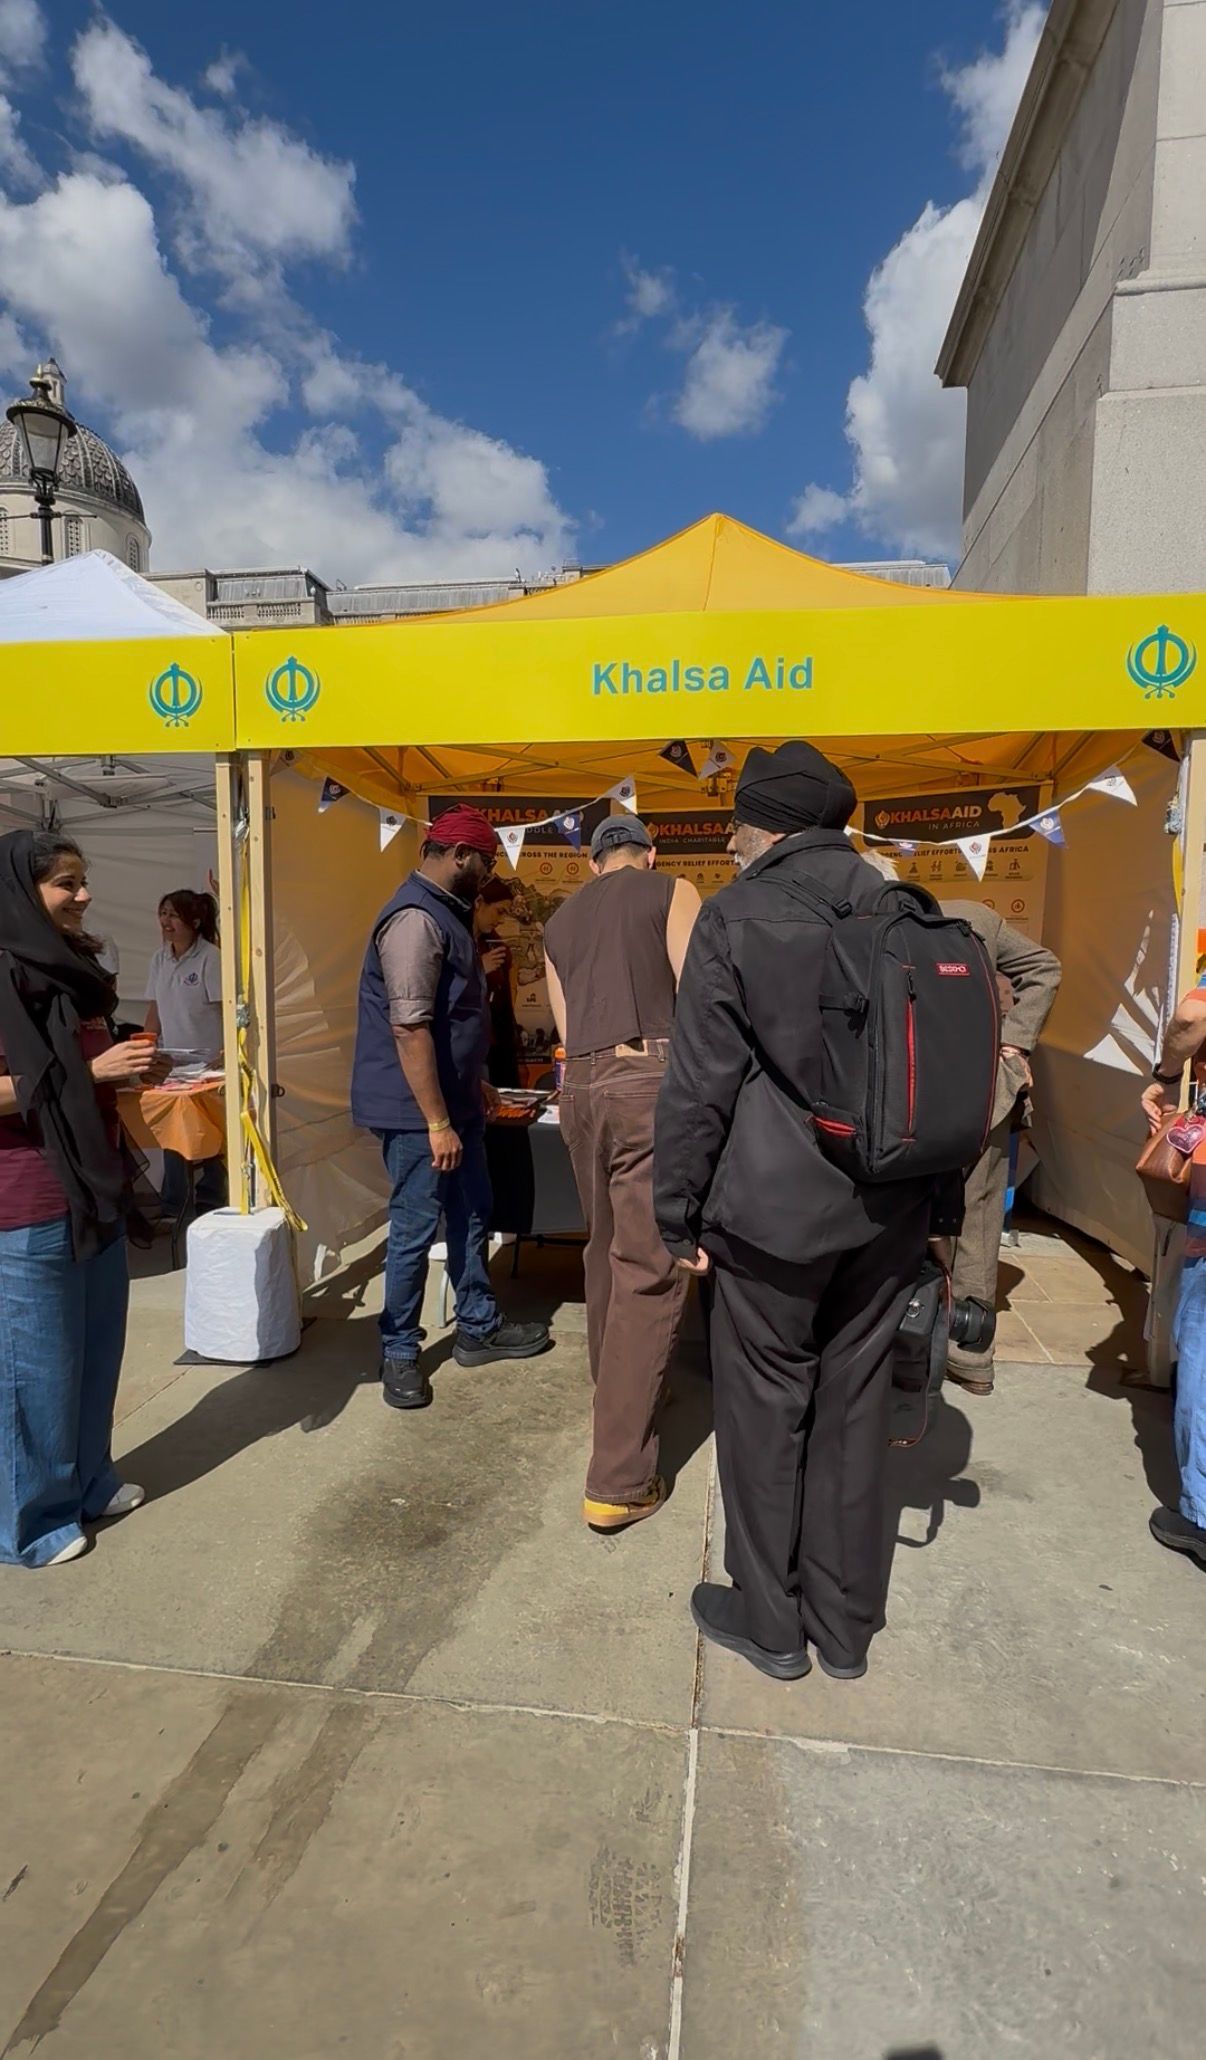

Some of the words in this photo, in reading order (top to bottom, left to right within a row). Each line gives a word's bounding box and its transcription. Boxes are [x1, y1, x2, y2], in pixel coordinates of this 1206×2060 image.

[593, 659, 729, 695] Khalsa
[744, 656, 813, 690] Aid
[890, 805, 982, 824] KHALSAAID
[659, 822, 736, 836] KHALSAA
[943, 820, 979, 830] AFRICA
[1000, 845, 1029, 853] AFRICA
